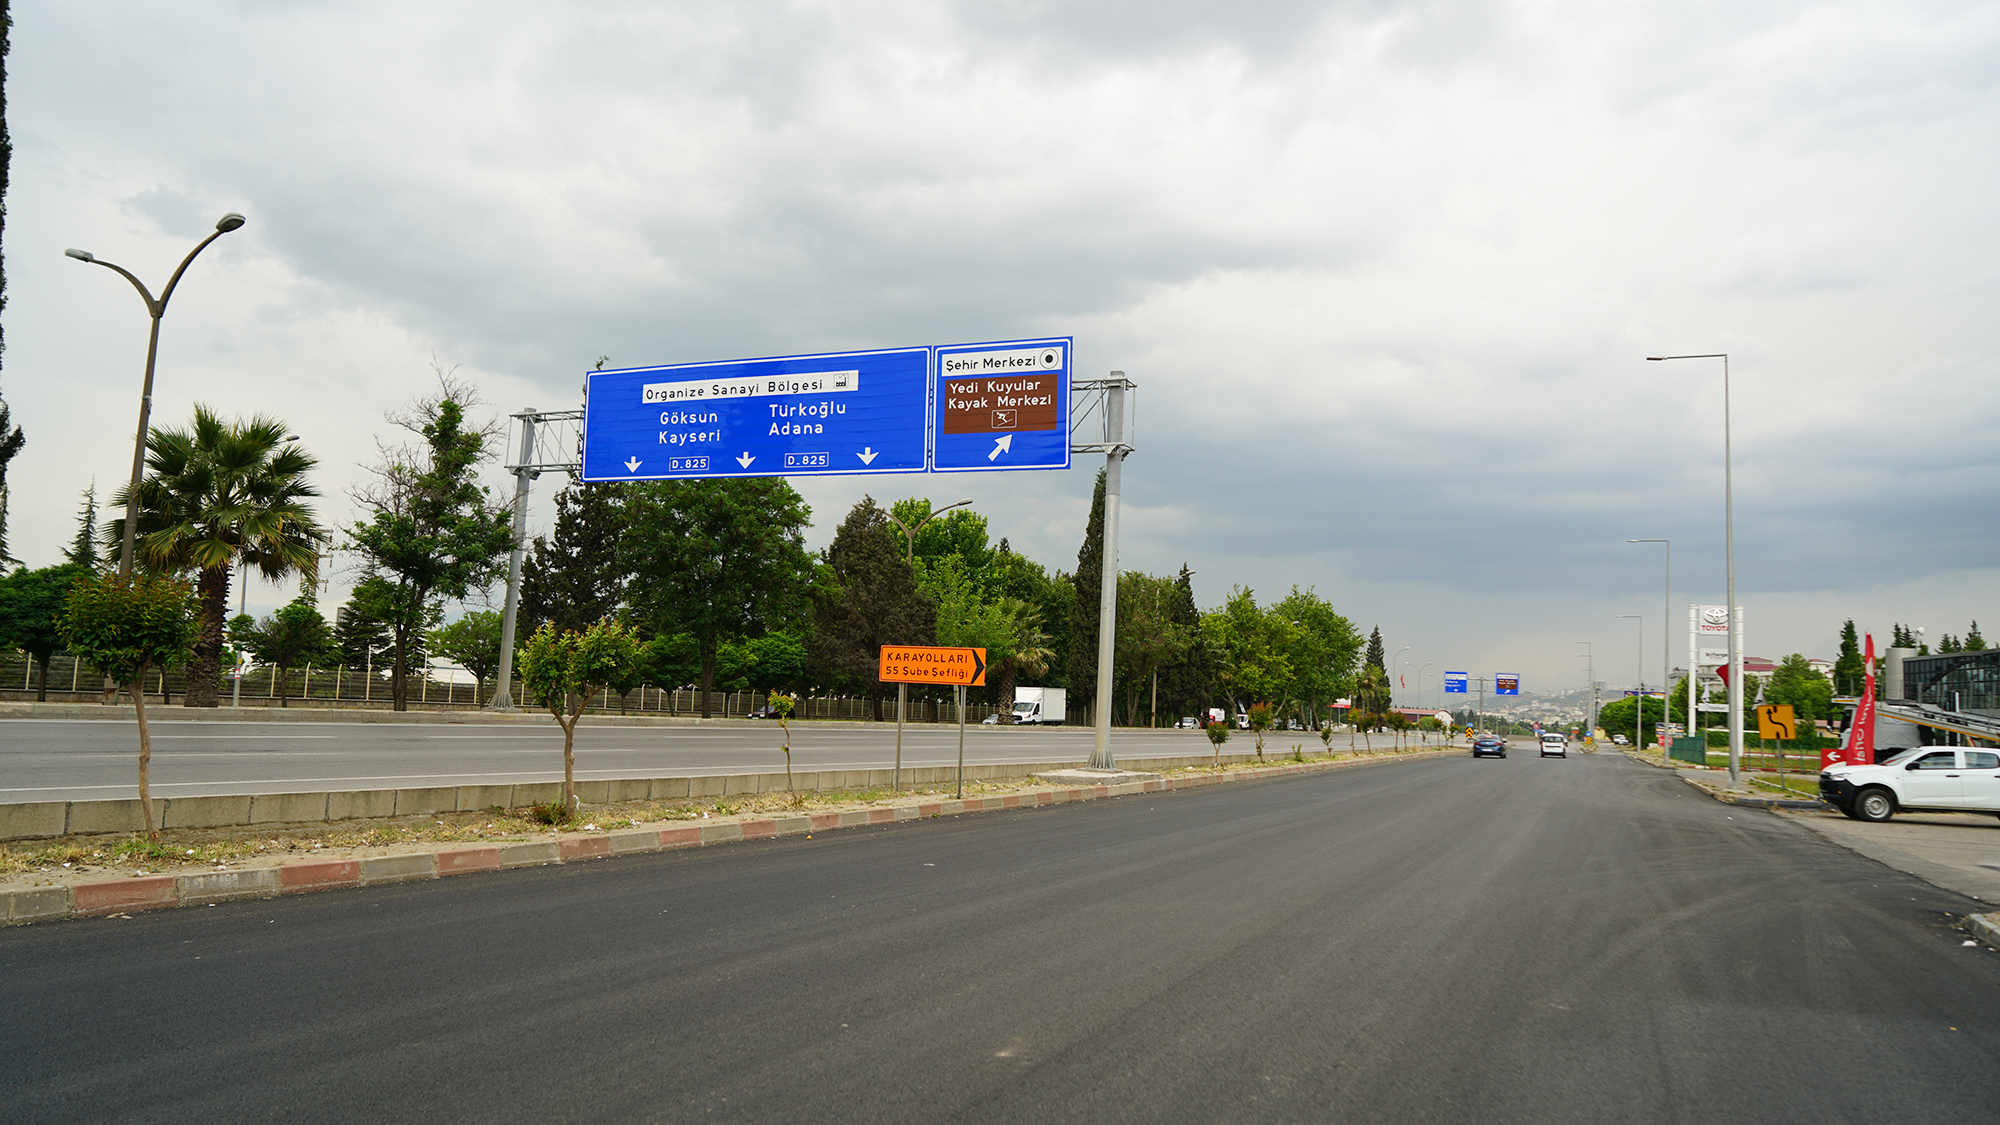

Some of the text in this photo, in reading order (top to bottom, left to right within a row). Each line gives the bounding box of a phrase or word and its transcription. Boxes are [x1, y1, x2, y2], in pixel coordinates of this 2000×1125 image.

[946, 356, 1036, 372] Şehir Merkezi
[646, 379, 823, 401] Organize Sanayi Bölgesi
[949, 379, 1041, 394] Yedi Kuyular
[769, 401, 846, 418] Türkoğlu
[948, 394, 1052, 411] Kayak Merkezi
[660, 411, 718, 425] Göksun
[769, 422, 823, 436] Adana
[659, 429, 721, 446] Kayseri
[672, 459, 707, 469] D.825
[787, 455, 826, 466] D.825
[887, 652, 968, 664] KARAYOLLARI
[932, 667, 968, 679] Şefliği
